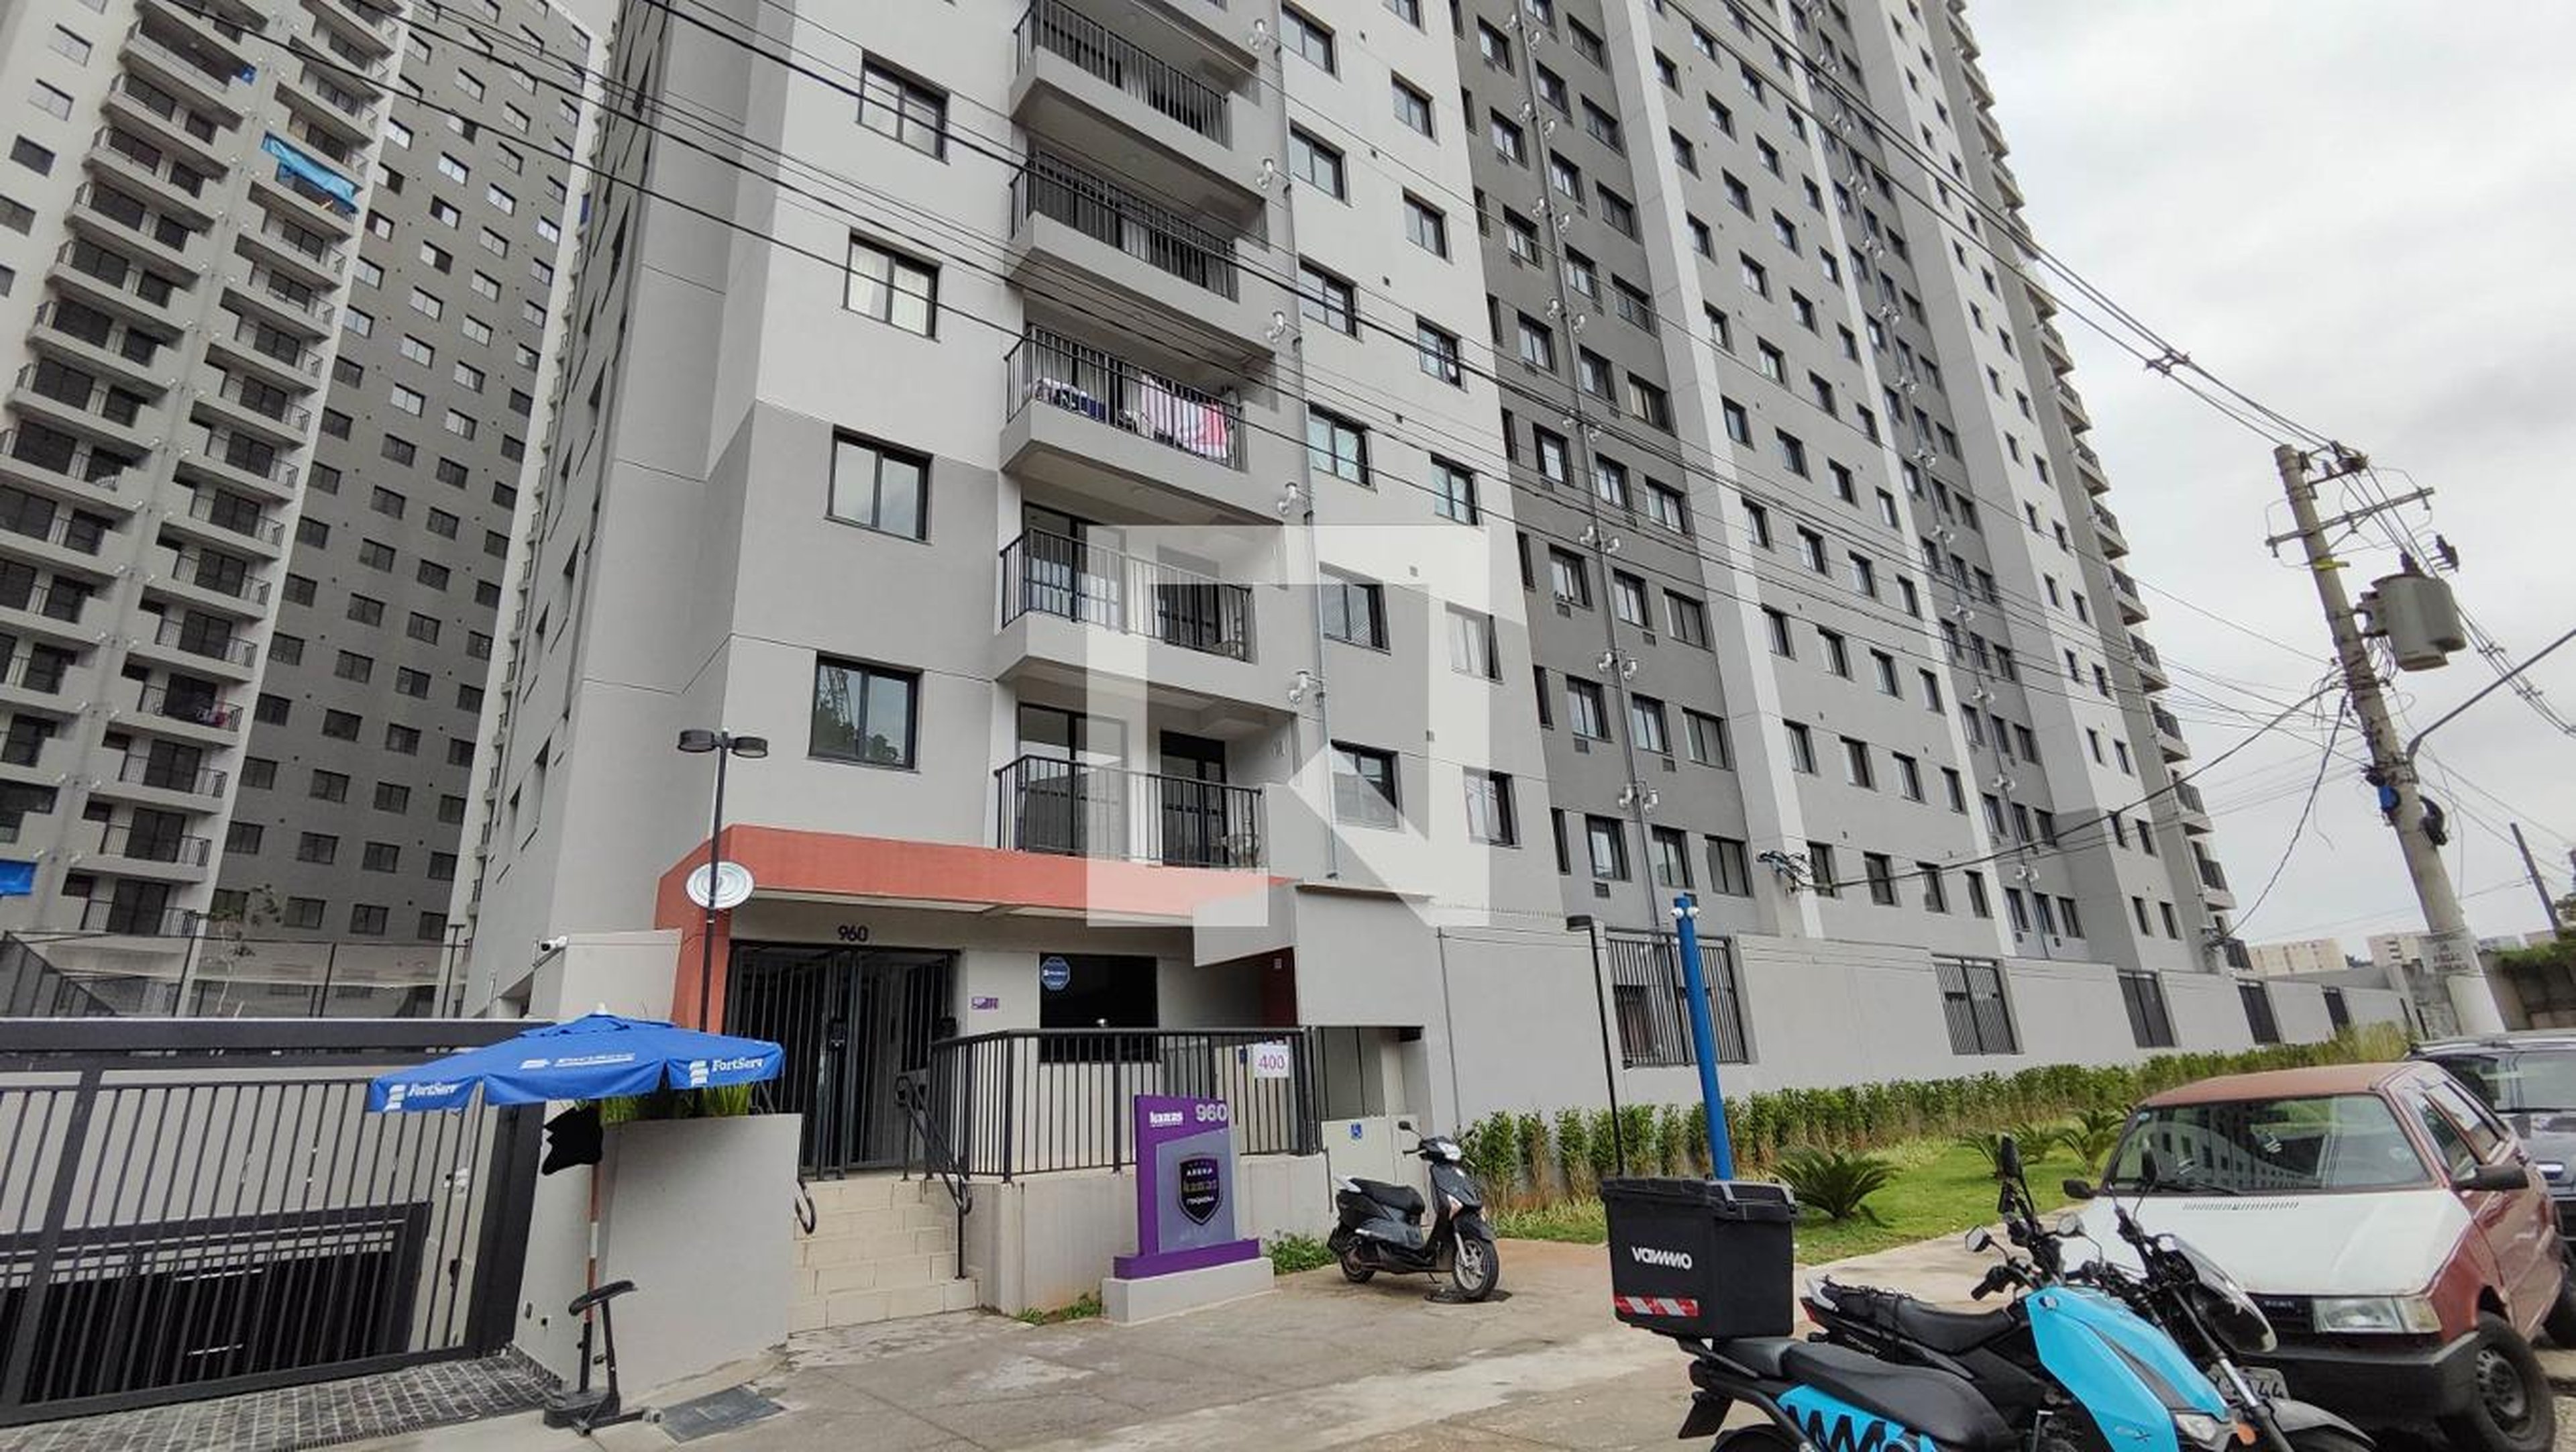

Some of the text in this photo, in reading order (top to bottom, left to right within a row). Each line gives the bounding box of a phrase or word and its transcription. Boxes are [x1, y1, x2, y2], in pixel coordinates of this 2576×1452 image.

[837, 925, 869, 942] 960
[712, 1057, 764, 1072] FortServ
[1258, 1054, 1285, 1070] 400
[408, 1082, 460, 1097] FortServ
[1195, 1103, 1228, 1121] 960
